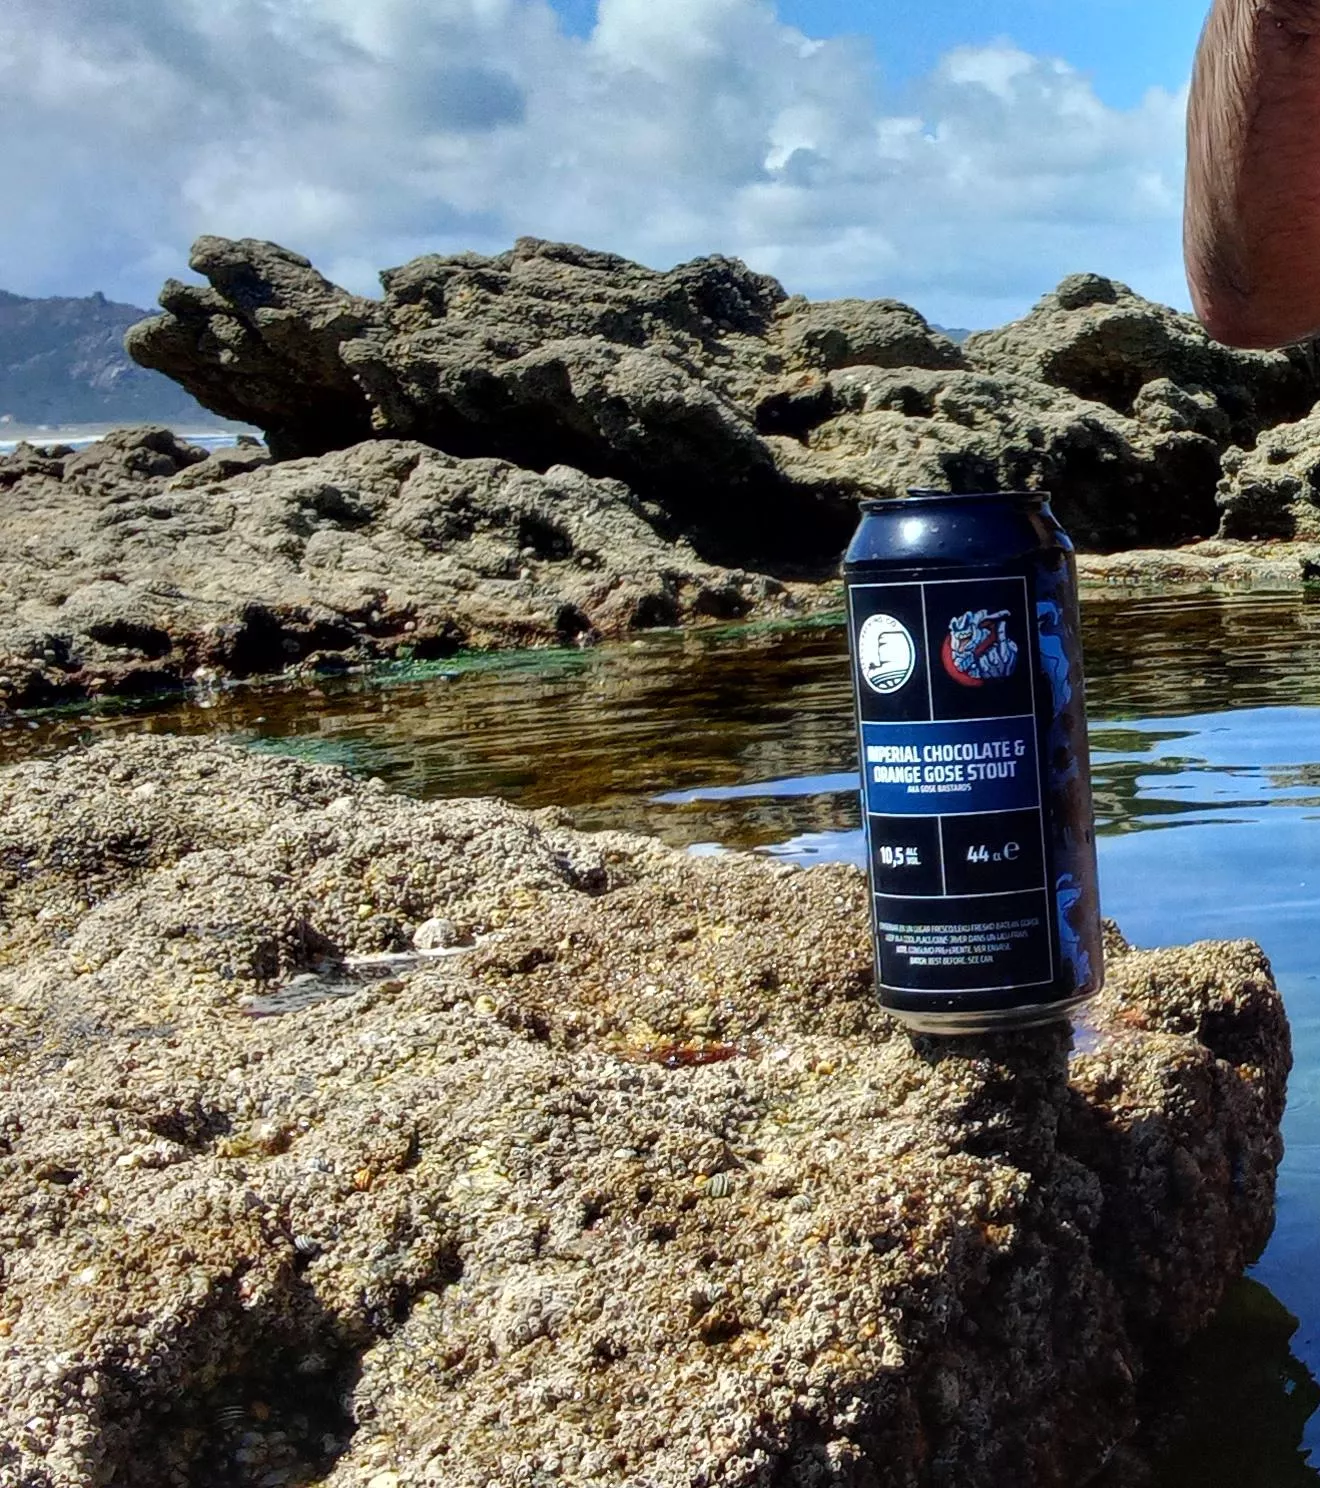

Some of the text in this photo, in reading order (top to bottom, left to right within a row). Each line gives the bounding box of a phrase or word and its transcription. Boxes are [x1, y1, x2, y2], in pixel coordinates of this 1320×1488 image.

[867, 740, 1025, 763] IMPERIAL CHOCOLATE &
[873, 761, 1017, 783] ORANGE GOSE STOUT
[880, 846, 904, 868] 10,5
[967, 844, 989, 863] 44
